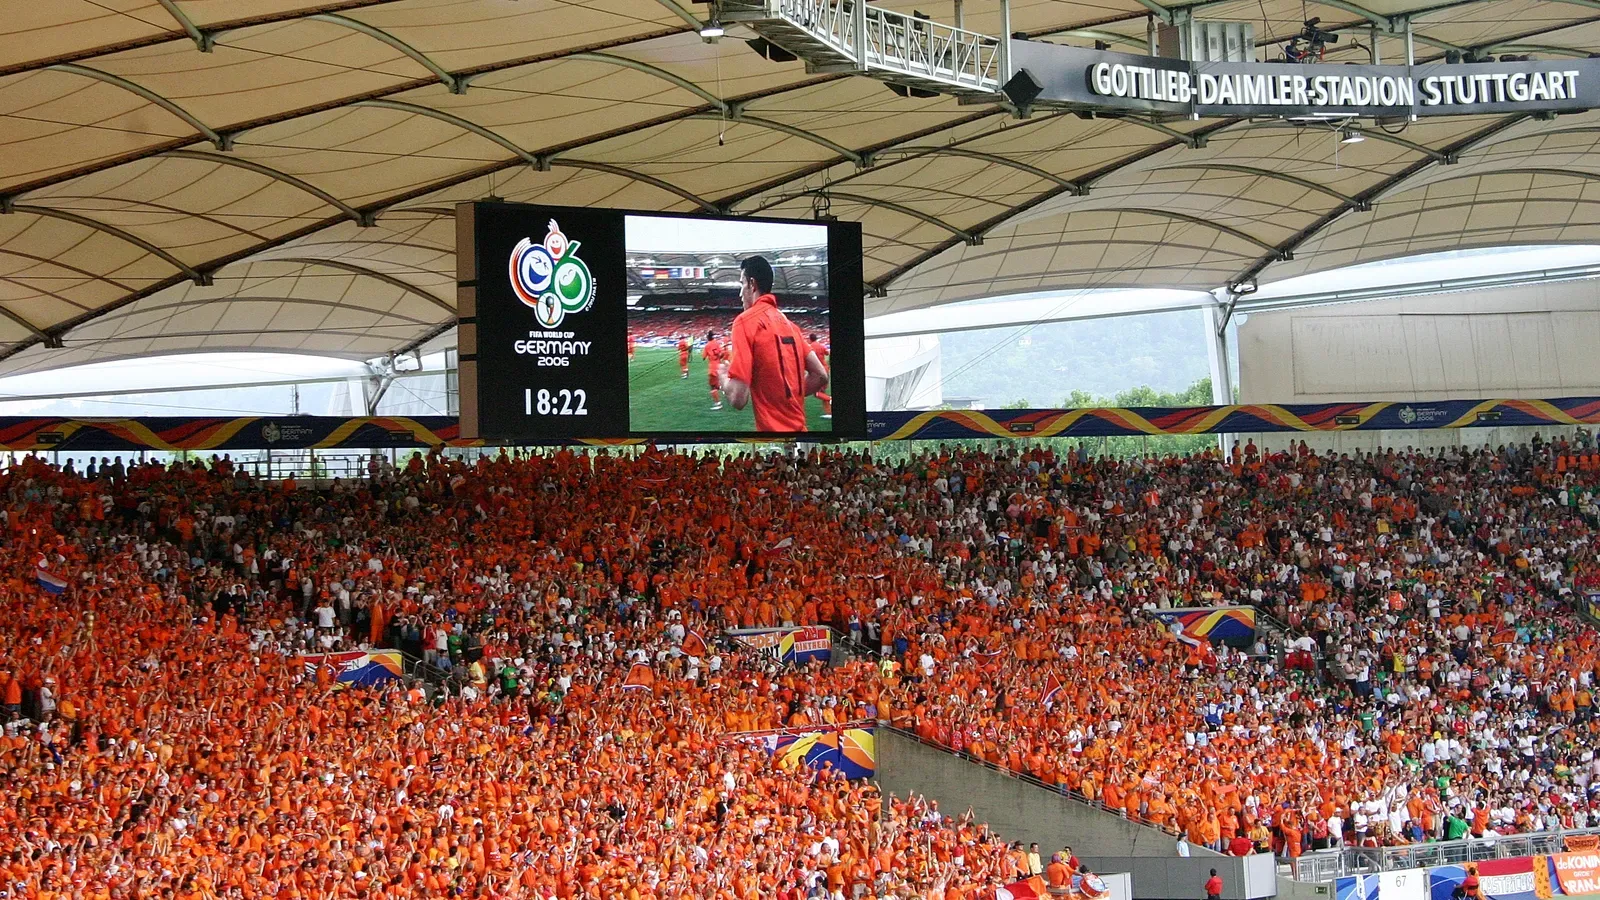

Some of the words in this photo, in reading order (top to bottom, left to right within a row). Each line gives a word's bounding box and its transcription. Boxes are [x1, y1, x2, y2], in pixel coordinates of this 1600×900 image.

[1093, 62, 1414, 106] GOTTLIEB-DAIMLER-STADION
[1424, 70, 1580, 105] STUTTGART
[514, 340, 592, 355] GERMANY
[537, 356, 570, 366] 2006
[525, 388, 588, 415] 18:22
[1395, 875, 1407, 887] 67
